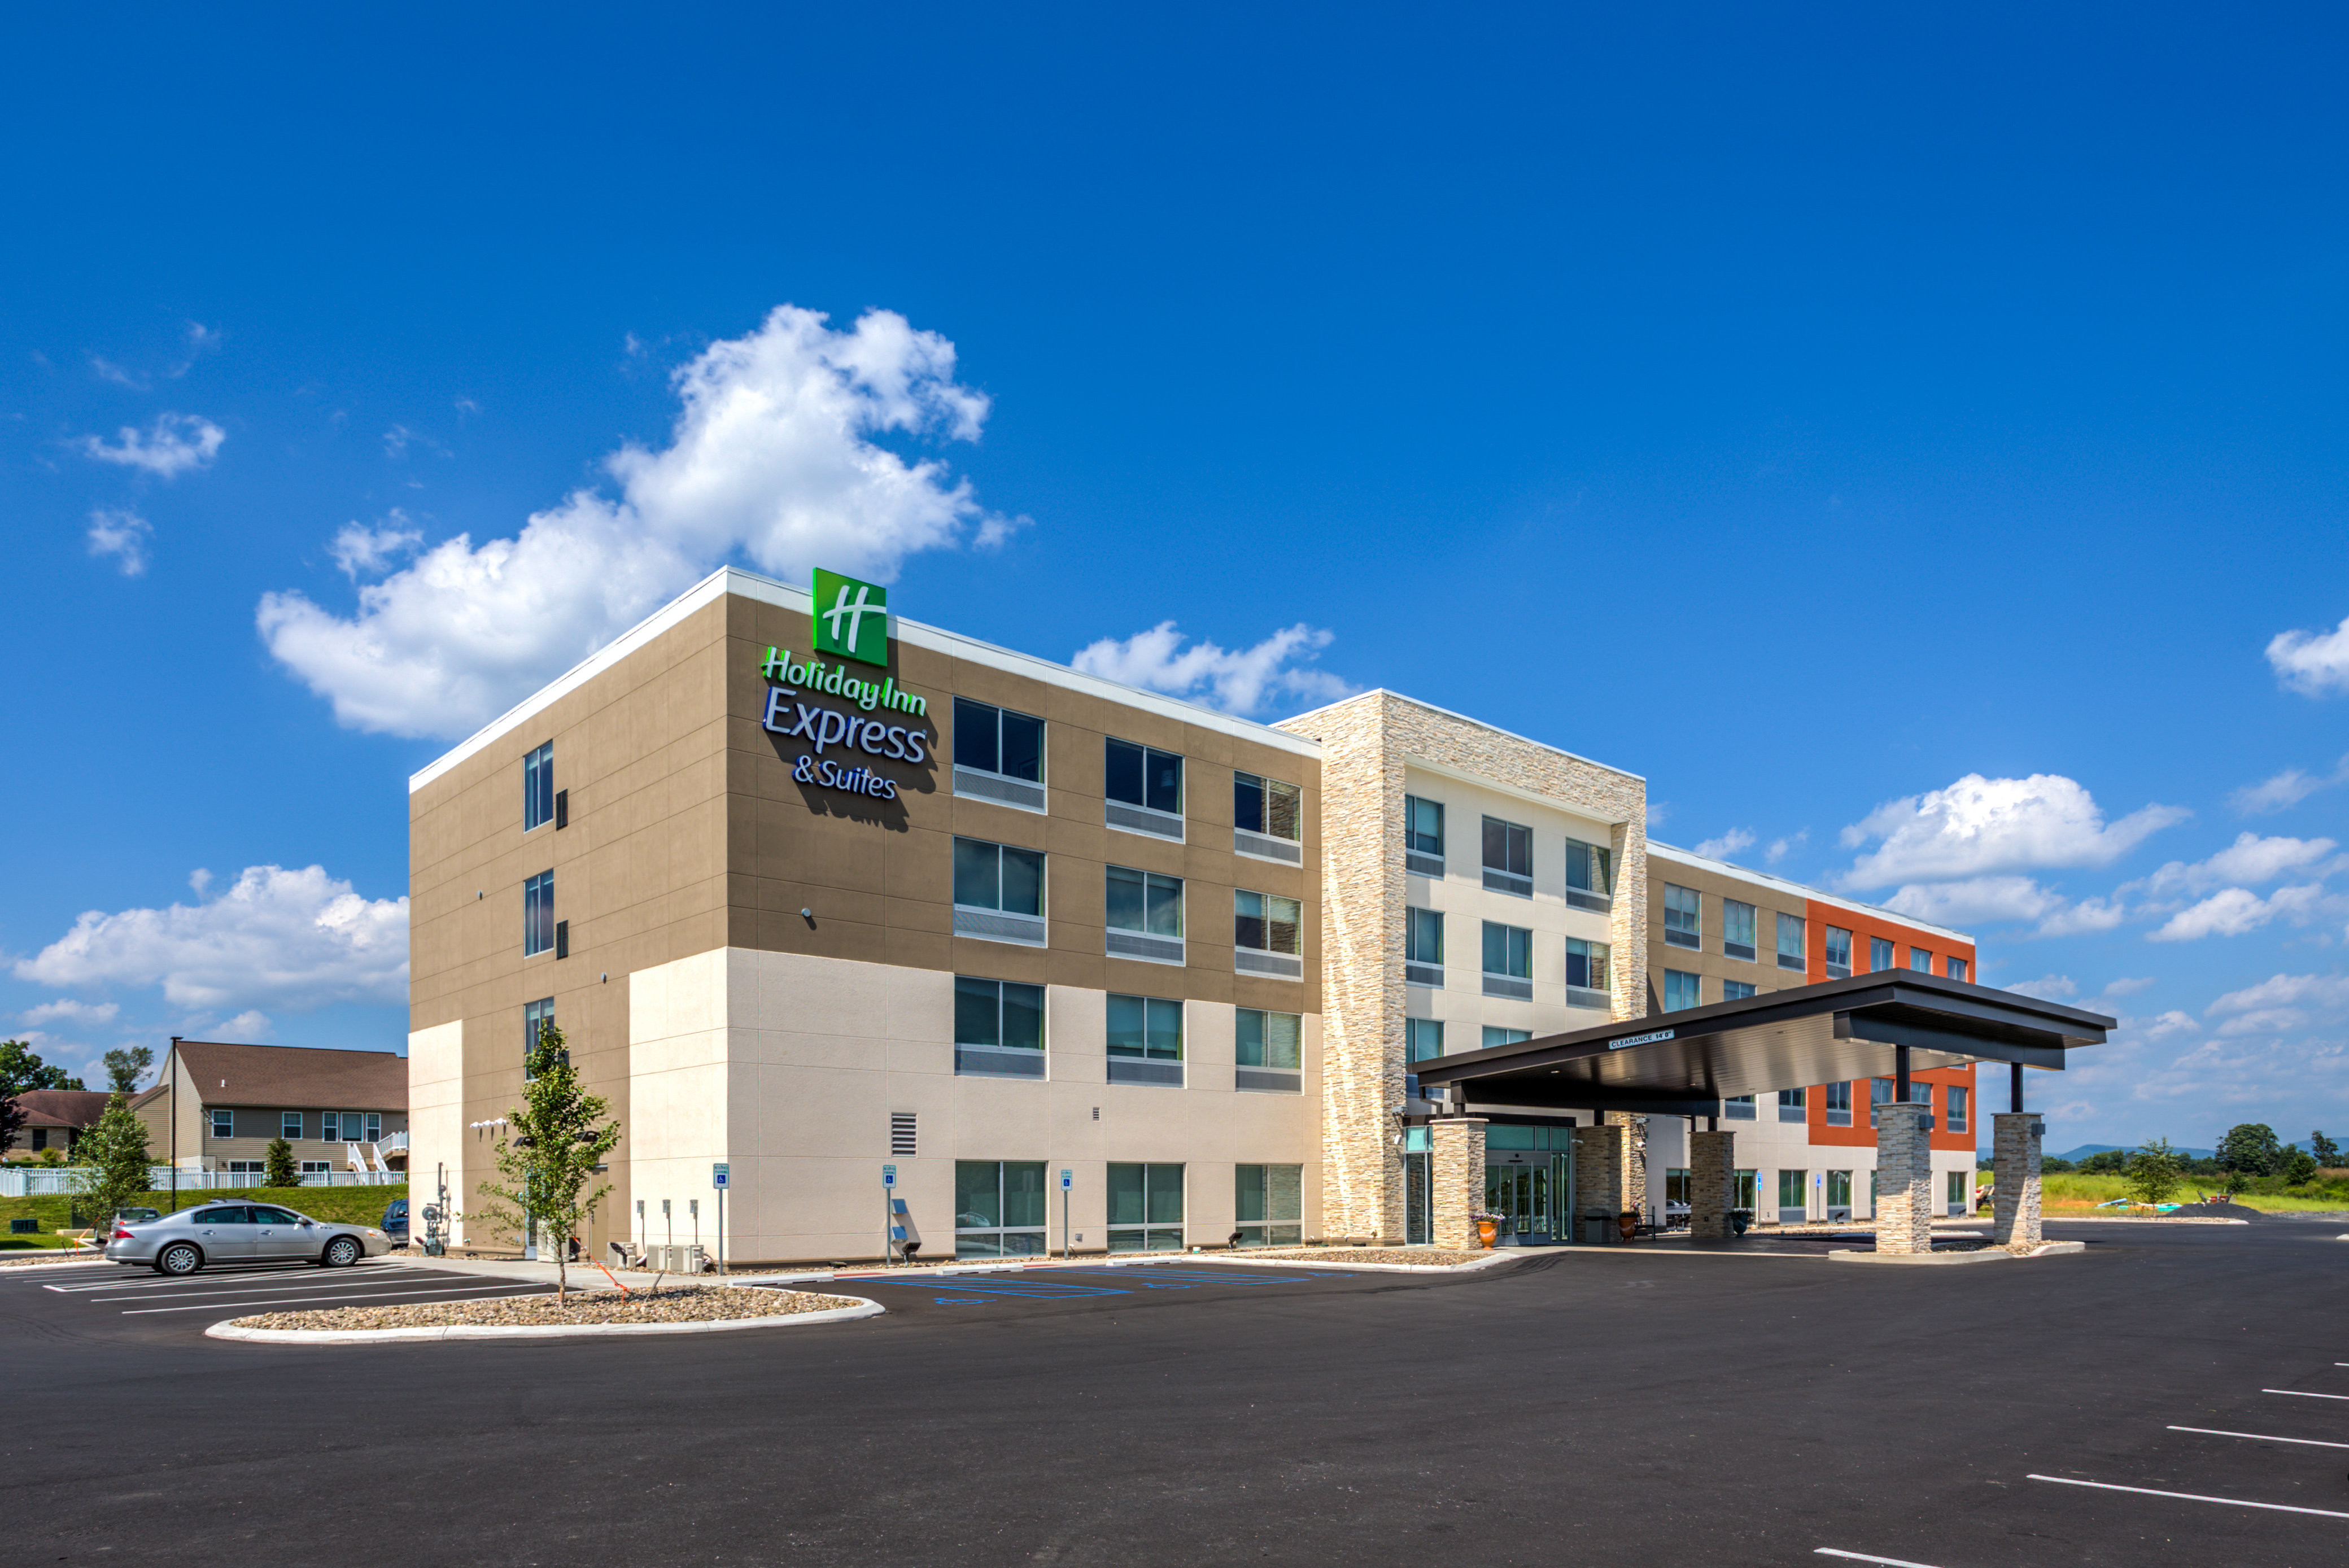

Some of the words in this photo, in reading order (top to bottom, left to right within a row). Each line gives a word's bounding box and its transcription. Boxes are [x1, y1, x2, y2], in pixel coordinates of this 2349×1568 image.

[762, 646, 879, 711] Holiday
[881, 677, 926, 717] Inn
[763, 687, 926, 763] Express
[792, 755, 814, 783] &
[817, 760, 896, 800] Suites
[1612, 1035, 1652, 1047] CLEARANCE
